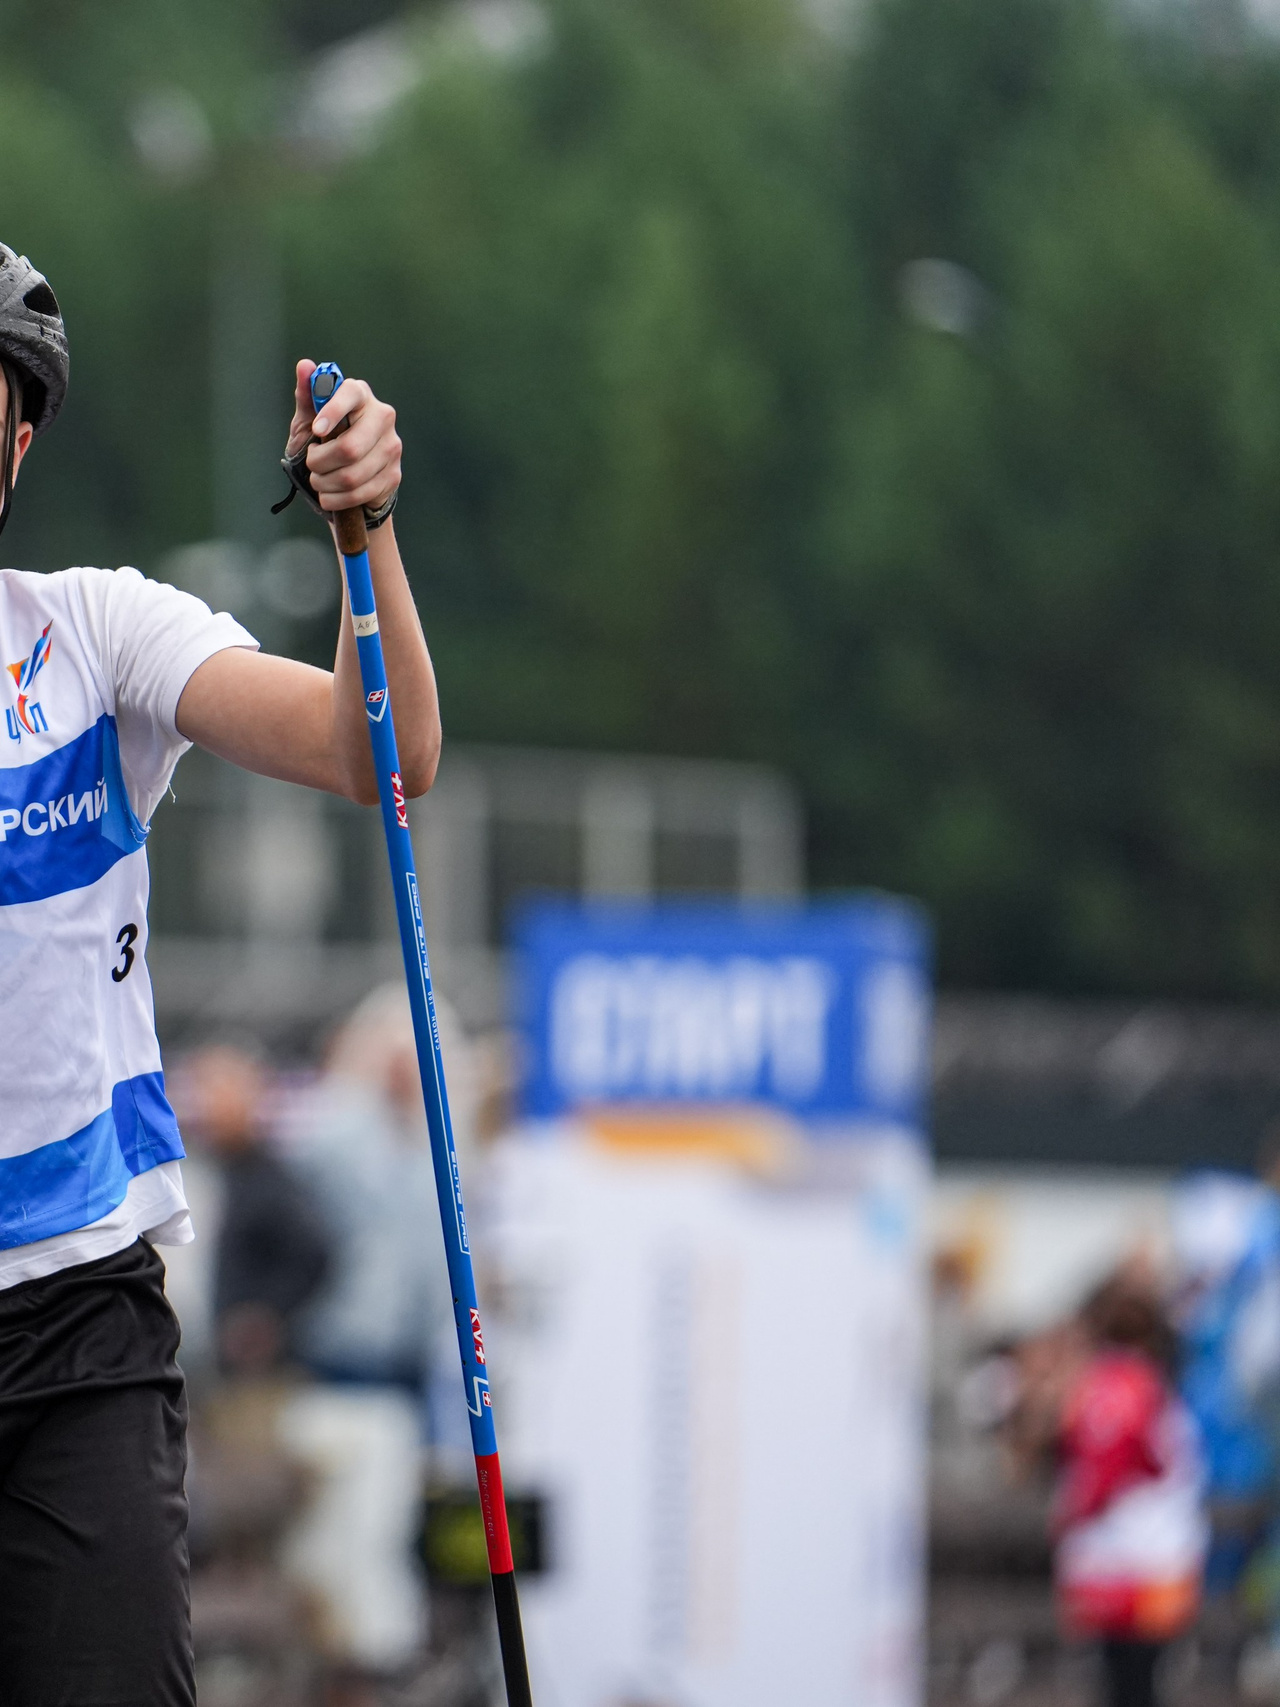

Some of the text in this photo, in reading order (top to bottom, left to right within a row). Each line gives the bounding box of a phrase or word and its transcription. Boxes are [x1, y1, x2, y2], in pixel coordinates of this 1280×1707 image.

[111, 923, 138, 982] 3
[411, 883, 430, 979] ELITE PRO
[431, 1015, 440, 1051] CARBON
